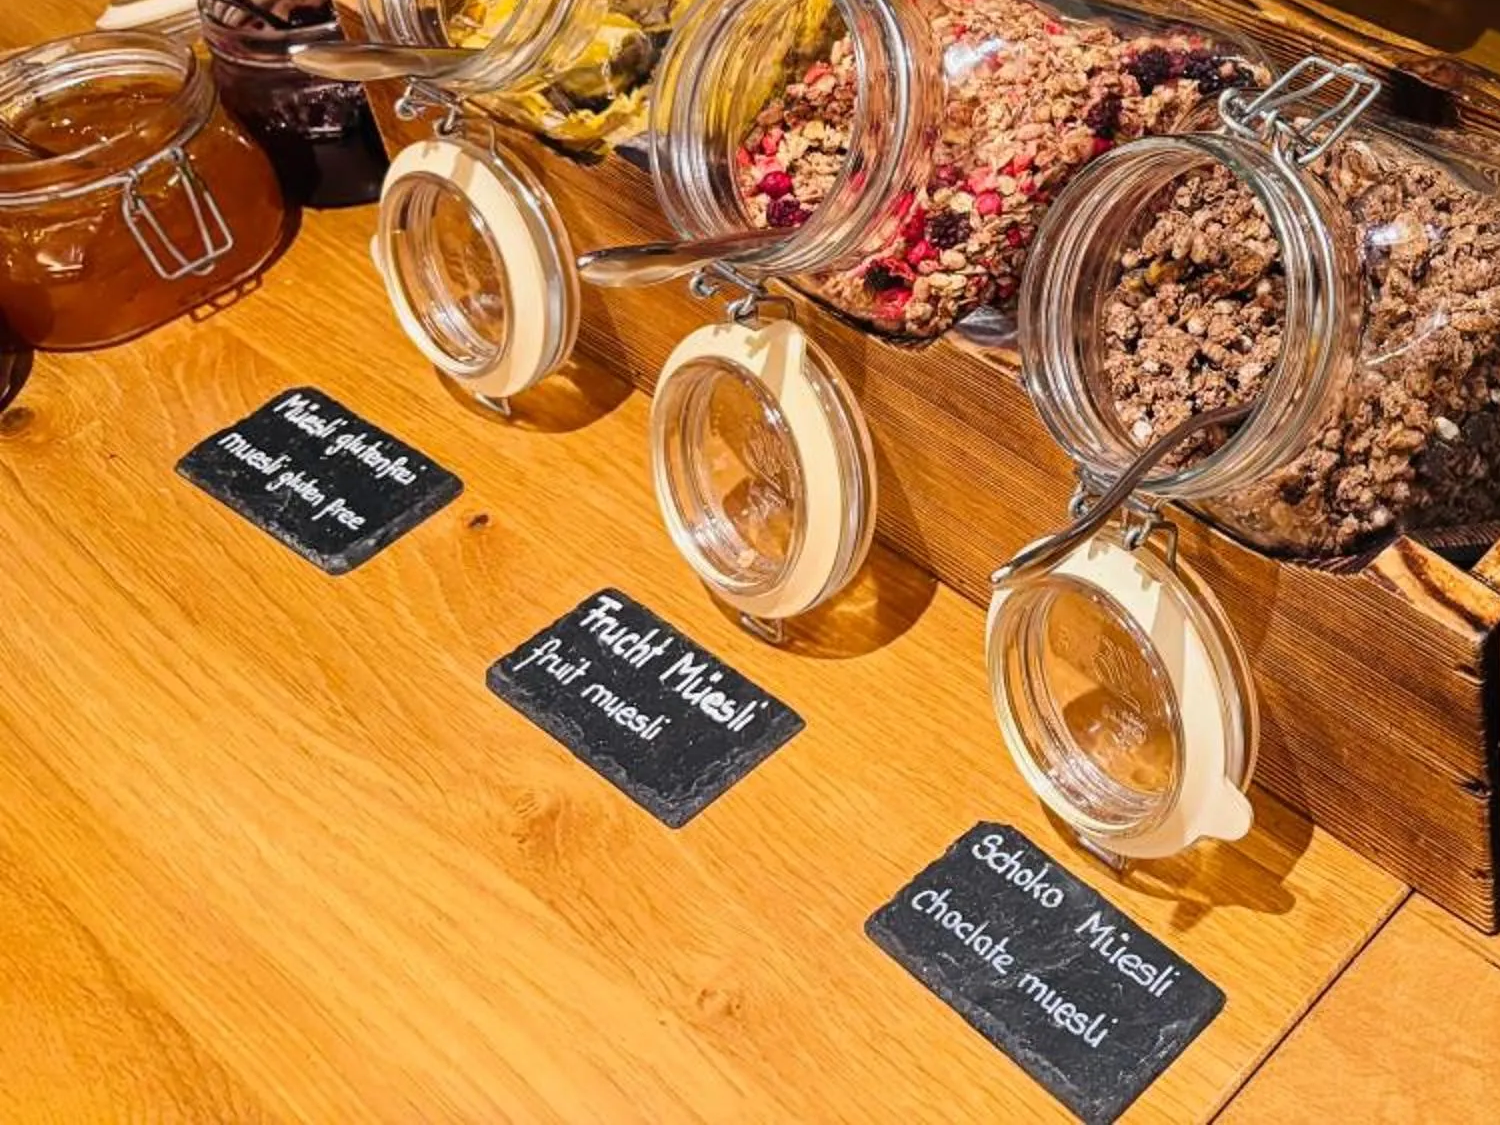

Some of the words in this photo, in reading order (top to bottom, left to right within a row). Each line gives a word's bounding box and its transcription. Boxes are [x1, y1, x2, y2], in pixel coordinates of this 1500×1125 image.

[265, 471, 326, 507] gluten
[311, 497, 367, 531] free
[579, 595, 674, 669] Frucht
[511, 637, 592, 686] fruit
[580, 683, 672, 741] muesli
[971, 833, 1065, 910] Schoko
[1017, 971, 1119, 1049] muesli
